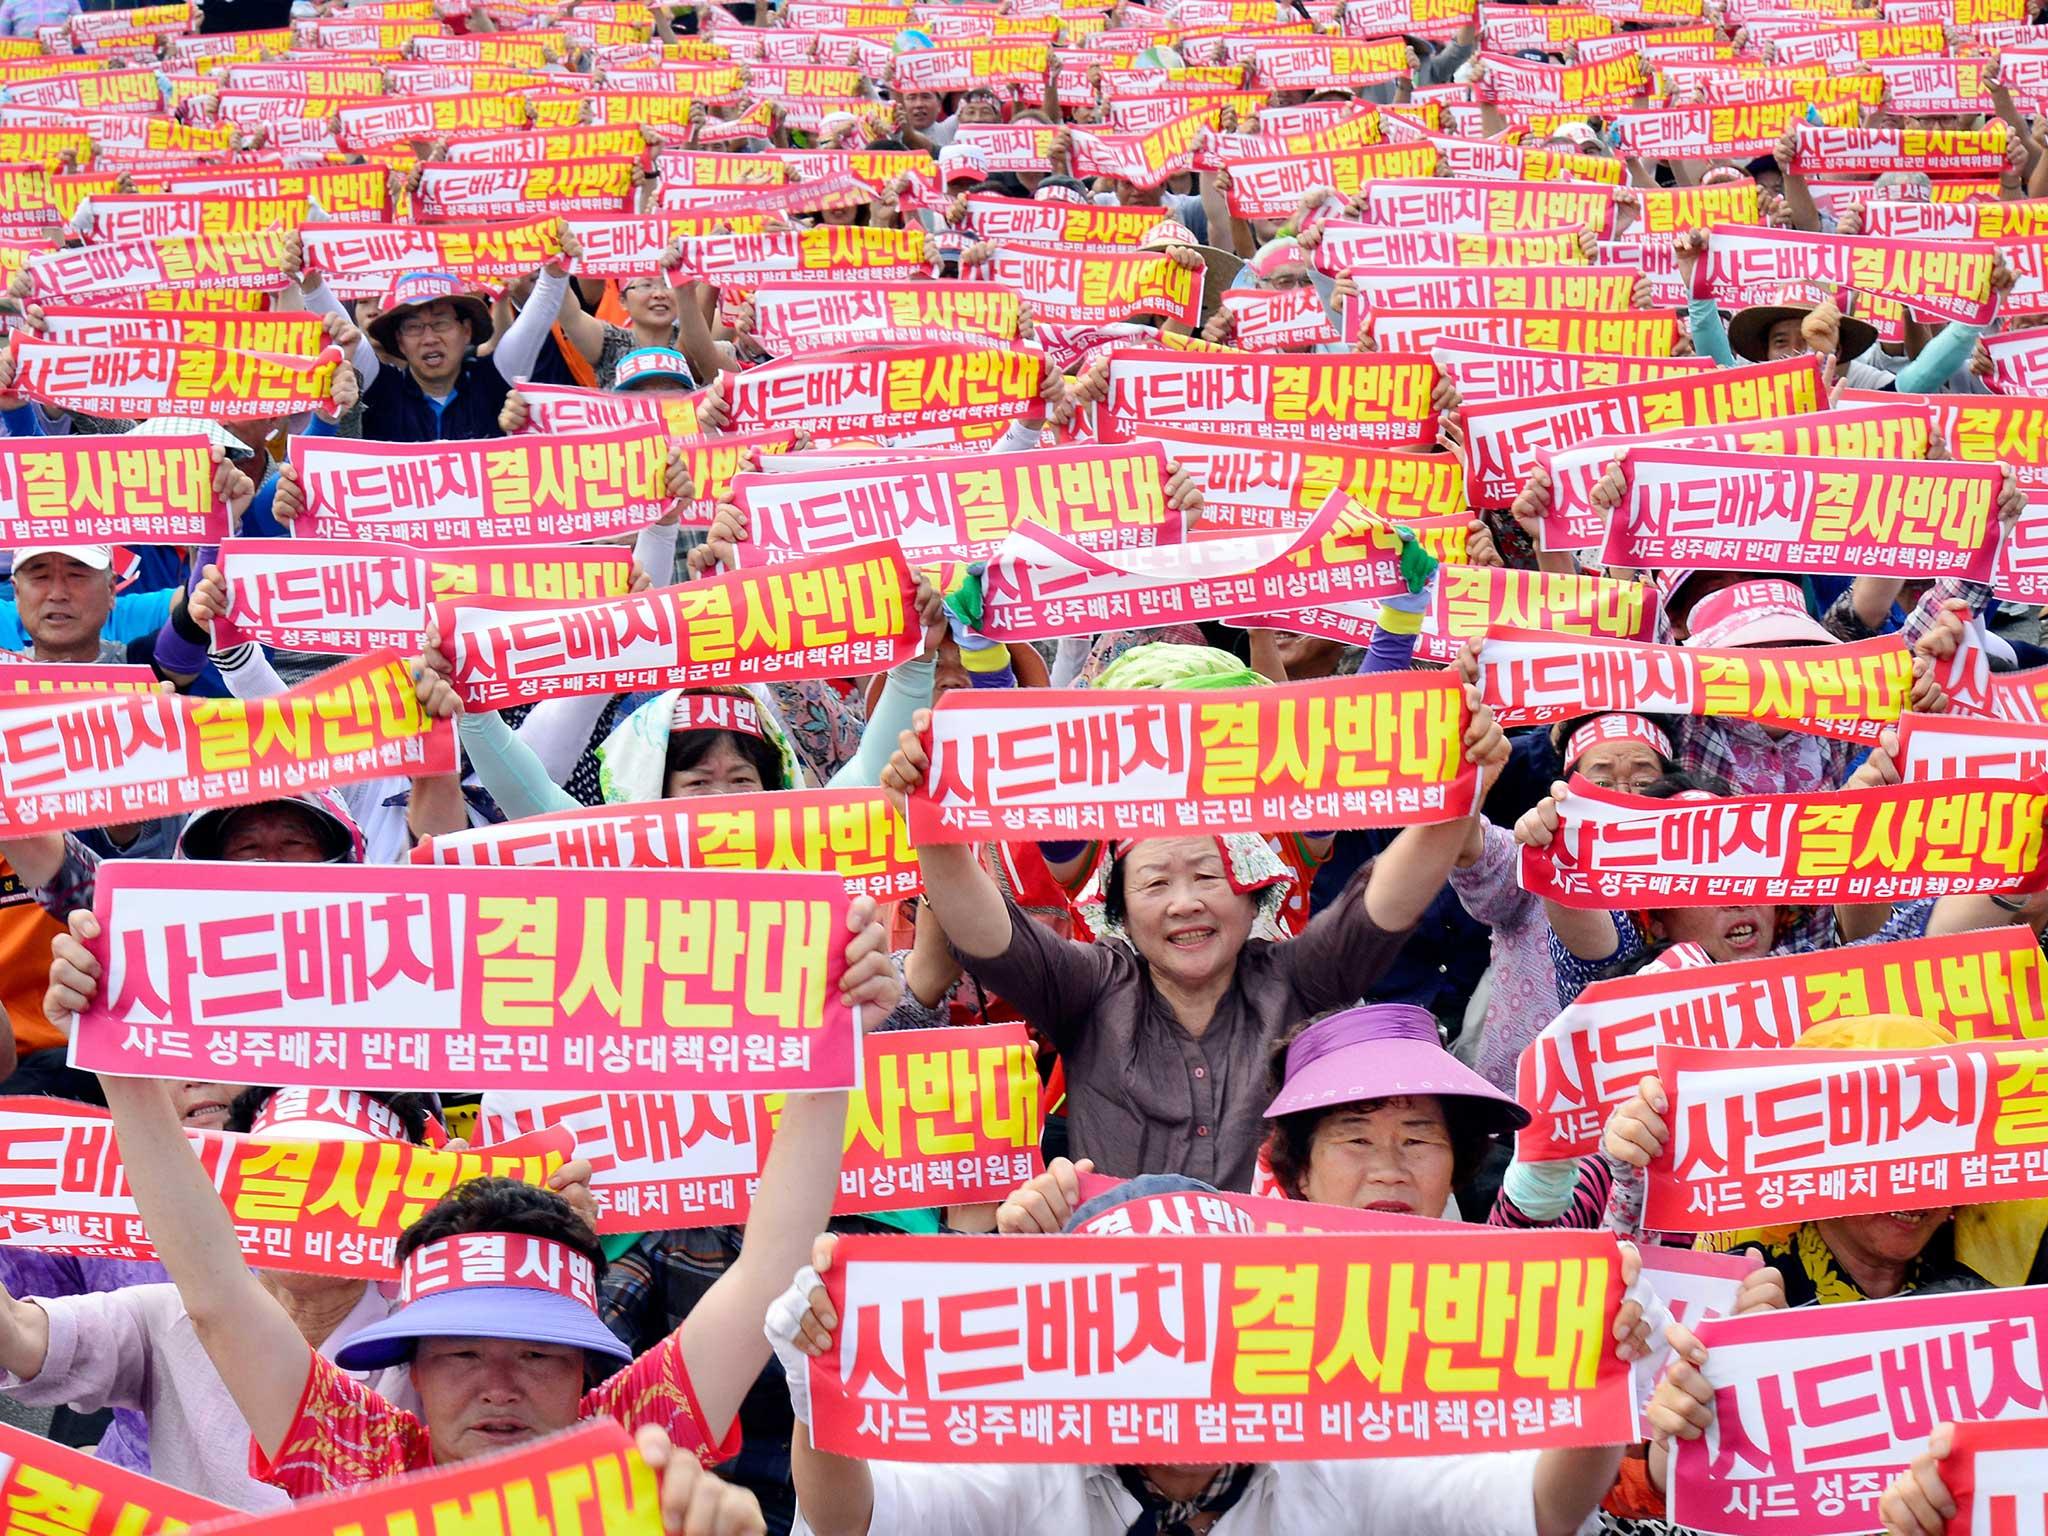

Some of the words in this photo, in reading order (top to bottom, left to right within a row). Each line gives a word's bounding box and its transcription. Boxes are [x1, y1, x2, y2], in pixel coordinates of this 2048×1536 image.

[898, 50, 968, 80] 사드배치
[972, 45, 1048, 77] 결사반대
[1259, 48, 1330, 82] 사드배치
[1332, 42, 1405, 74] 결사반대
[1857, 24, 1943, 59] 결사반대
[77, 73, 160, 108] 결사반대
[607, 97, 691, 126] 결사반대
[342, 102, 431, 138] 사드배치
[434, 95, 527, 129] 결사반대
[1620, 111, 1706, 148] 사드배치
[419, 168, 520, 201] 사드배치
[524, 163, 635, 200] 결사반대
[1234, 157, 1329, 202] 사드배치
[1825, 157, 1867, 169] 성주배치
[1870, 156, 1892, 168] 반대
[1895, 156, 1925, 168] 범군민
[447, 202, 488, 215] 성주배치
[491, 201, 512, 214] 반대
[516, 201, 546, 214] 범군민
[549, 197, 623, 213] 비상대책위원회
[1374, 189, 1483, 230] 사드배치
[1487, 189, 1605, 233] 결사반대
[1646, 182, 1759, 233] 결사반대
[1867, 203, 1974, 237] 사드배치
[1081, 258, 1191, 306] 결사반대
[1710, 245, 1844, 284] 사드배치
[1852, 245, 1993, 304] 결사반대
[761, 291, 879, 337] 사드배치
[888, 292, 1018, 341] 결사반대
[796, 333, 844, 350] 성주배치
[851, 330, 877, 343] 반대
[15, 348, 168, 395] 사드배치
[734, 363, 885, 423] 사드배치
[888, 350, 1038, 411] 결사반대
[1110, 365, 1266, 419] 사드배치
[1271, 364, 1433, 423] 결사반대
[121, 398, 152, 413] 반대
[157, 398, 205, 415] 범군민
[872, 413, 917, 429] 범군민
[921, 399, 1029, 424] 비상대책위원회
[1257, 420, 1305, 438] 범군민
[1311, 420, 1421, 439] 비상대책위원회
[19, 448, 212, 517] 결사반대
[309, 454, 478, 519] 사드배치
[486, 435, 666, 515] 결사반대
[1484, 479, 1517, 500] 사드
[13, 518, 68, 538] 범군민
[76, 515, 206, 537] 비상대책위원회
[315, 521, 352, 539] 사드
[357, 521, 427, 541] 성주배치
[434, 519, 471, 539] 반대
[477, 517, 532, 537] 범군민
[538, 503, 662, 535] 비상대책위원회
[756, 474, 954, 552] 사드배치
[955, 456, 1165, 544] 결사반대
[1241, 507, 1274, 528] 반대
[1629, 472, 1804, 536] 사드배치
[1810, 472, 1994, 549] 결사반대
[1630, 539, 1665, 558] 사드
[1670, 540, 1739, 560] 성주배치
[1746, 544, 1781, 562] 반대
[1787, 545, 1839, 565] 범군민
[1844, 546, 1972, 569] 비상대책위원회
[228, 559, 421, 629] 사드배치
[993, 609, 1035, 632] 사드
[1042, 594, 1132, 626] 성주배치
[1138, 588, 1183, 614] 반대
[1190, 579, 1258, 607] 범군민
[1444, 565, 1643, 639] 결사반대
[281, 628, 358, 650] 성주배치
[367, 630, 408, 649] 반대
[459, 594, 673, 684] 사드배치
[680, 557, 904, 663] 결사반대
[468, 683, 509, 705] 사드
[517, 674, 607, 698] 성주배치
[616, 671, 660, 691] 반대
[667, 663, 731, 685] 범군민
[740, 639, 895, 673] 비상대책위원회
[1482, 649, 1690, 711] 사드배치
[1700, 650, 1914, 722] 결사반대
[193, 662, 432, 771] 결사반대
[930, 705, 1183, 806] 사드배치
[1200, 687, 1462, 796] 결사반대
[16, 791, 112, 825] 성주배치
[122, 783, 169, 810] 반대
[179, 771, 249, 803] 범군민
[259, 739, 426, 789] 비상대책위원회
[941, 805, 992, 830] 사드
[1002, 805, 1104, 830] 성주배치
[1115, 801, 1167, 829] 반대
[1175, 800, 1252, 827] 범군민
[1263, 785, 1446, 820] 비상대책위원회
[1551, 803, 1786, 870] 사드배치
[1797, 792, 2047, 876] 결사반대
[1599, 873, 1697, 895] 성주배치
[1708, 876, 1756, 896] 반대
[1765, 877, 1838, 897] 범군민
[109, 895, 455, 1026] 사드배치
[476, 896, 831, 1028] 결사반대
[121, 1026, 192, 1058] 사드
[205, 1032, 347, 1070] 성주배치
[362, 1034, 429, 1071] 반대
[445, 1034, 548, 1071] 범군민
[564, 1034, 811, 1073] 비상대책위원회
[1673, 1052, 1979, 1184] 사드배치
[679, 1181, 735, 1212] 반대
[841, 1154, 1034, 1198] 비상대책위원회
[1687, 1181, 1745, 1216] 사드
[1756, 1165, 1876, 1209] 성주배치
[1890, 1159, 1948, 1194] 반대
[1961, 1149, 2048, 1188] 범군민
[842, 1264, 1206, 1400] 사드배치
[1232, 1258, 1608, 1396] 결사반대
[857, 1402, 930, 1443] 사드
[944, 1403, 1092, 1446] 성주배치
[1107, 1402, 1179, 1445] 반대
[1195, 1402, 1303, 1444] 범군민
[1322, 1397, 1582, 1443] 비상대책위원회
[1723, 1483, 1798, 1521] 사드
